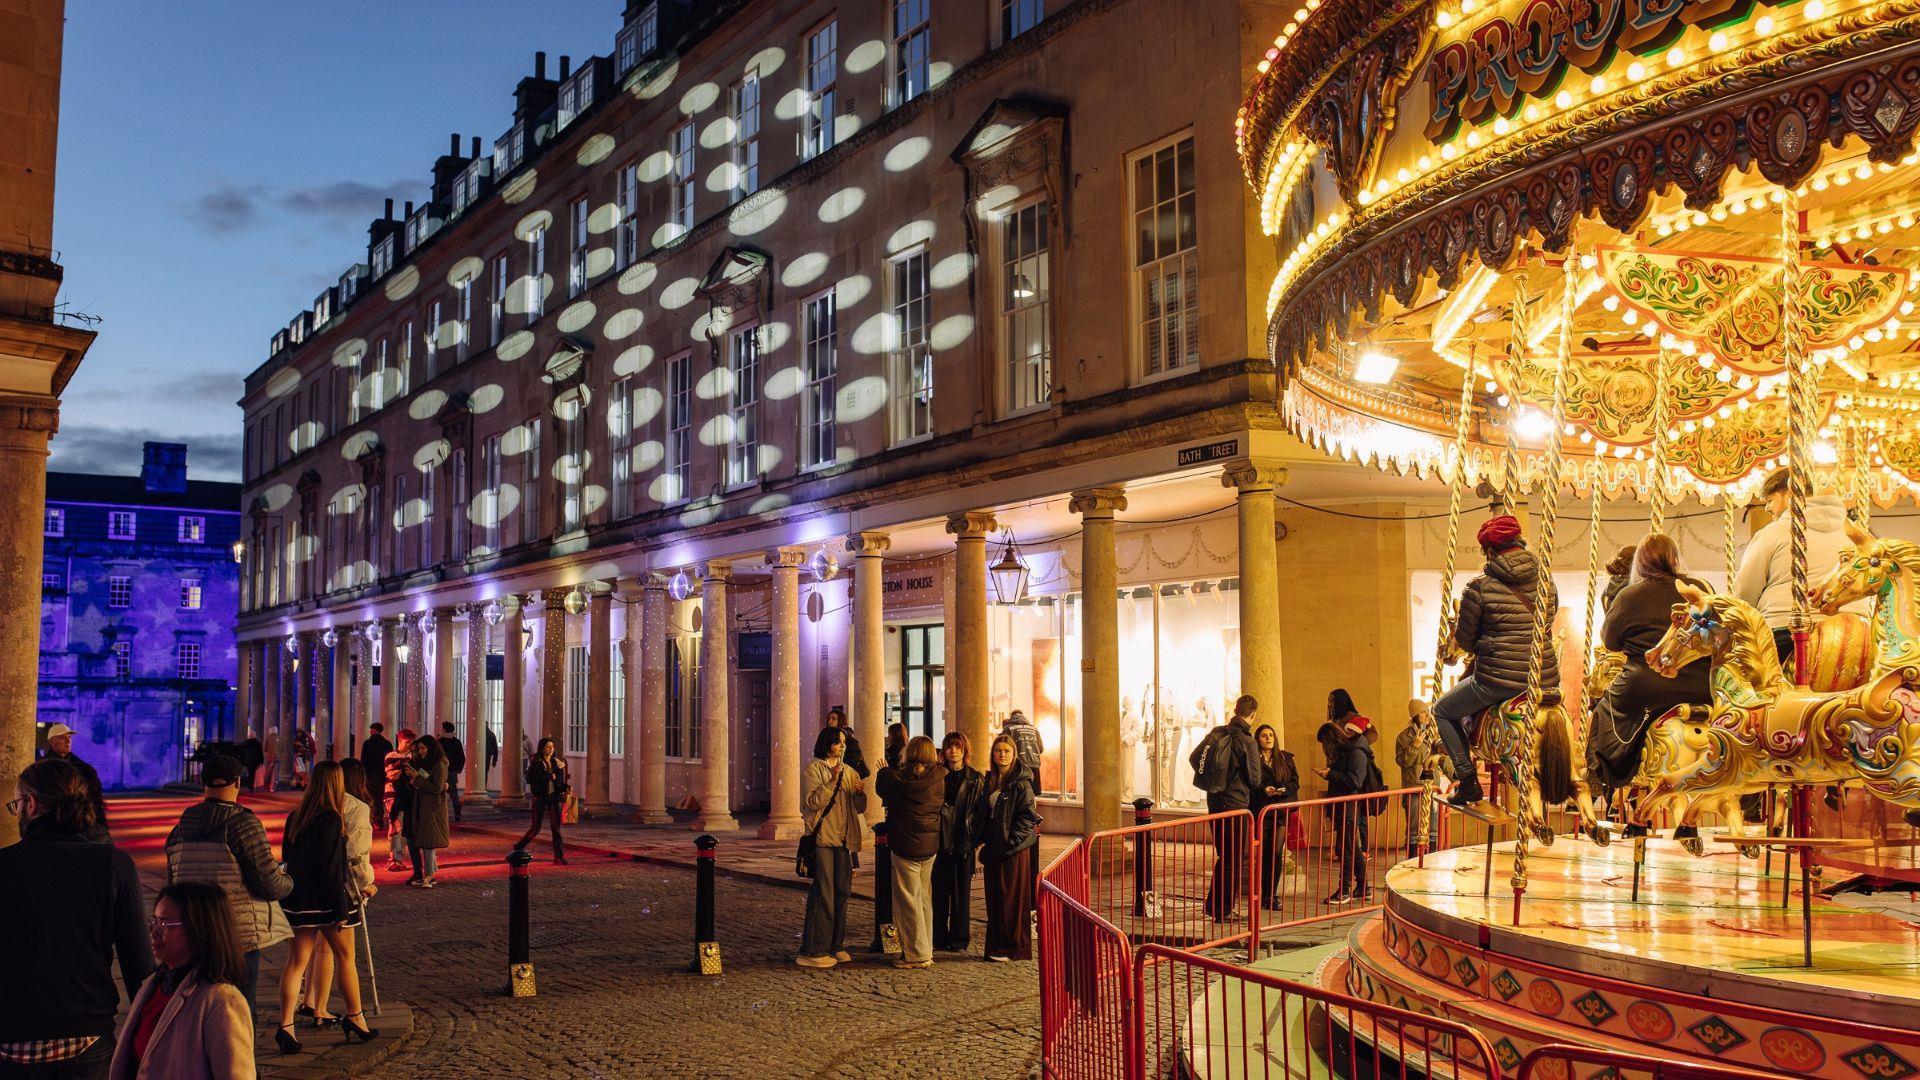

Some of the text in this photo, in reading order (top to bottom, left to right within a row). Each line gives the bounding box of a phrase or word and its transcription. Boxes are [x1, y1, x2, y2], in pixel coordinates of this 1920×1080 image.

[1180, 442, 1236, 464] BATH TREET
[906, 576, 933, 590] HOUSE
[1198, 745, 1210, 774] adidas
